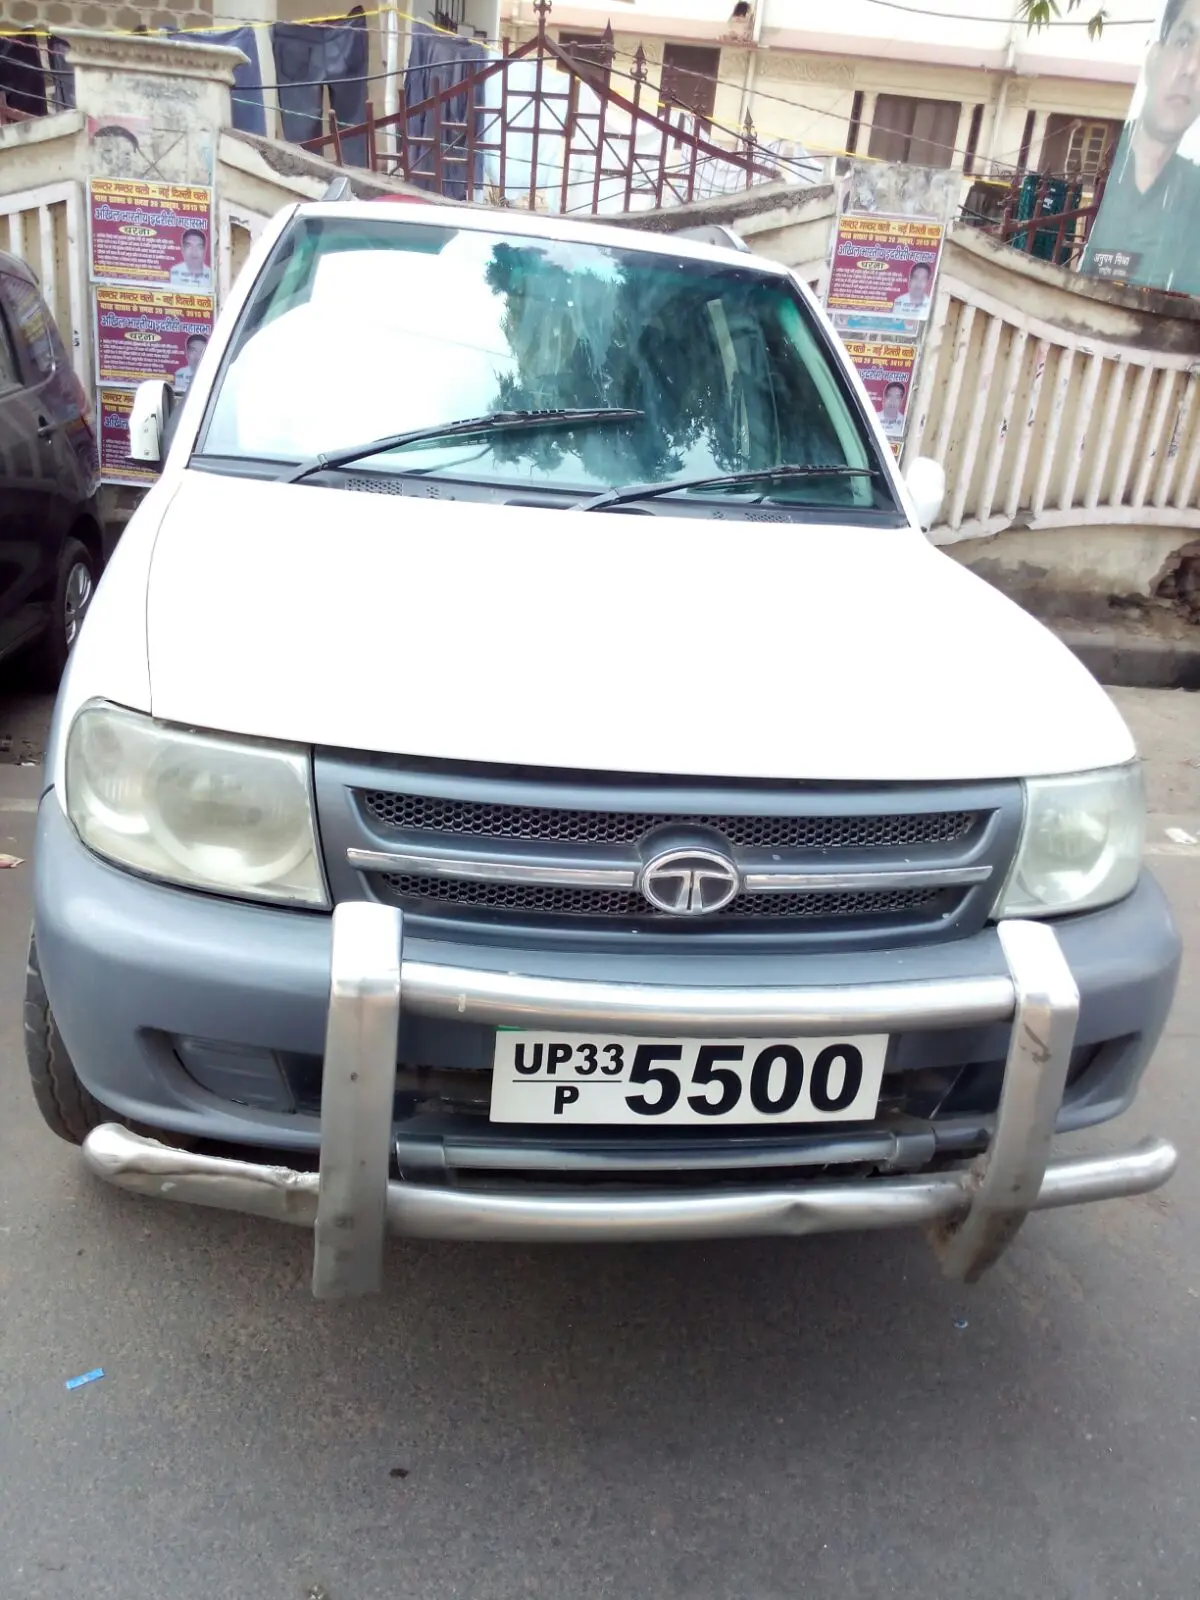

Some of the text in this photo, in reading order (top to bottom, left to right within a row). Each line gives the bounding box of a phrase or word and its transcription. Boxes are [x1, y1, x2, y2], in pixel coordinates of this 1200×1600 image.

[95, 204, 121, 222] अखिल
[121, 208, 149, 225] भारतीय
[838, 241, 860, 257] अखिल
[860, 244, 886, 258] भारतीय
[1094, 254, 1113, 266] अनुपम
[101, 312, 125, 328] अखिल
[125, 315, 154, 330] भारतीय
[514, 1043, 624, 1075] UP33
[625, 1043, 863, 1116] 5500
[553, 1085, 579, 1114] P
